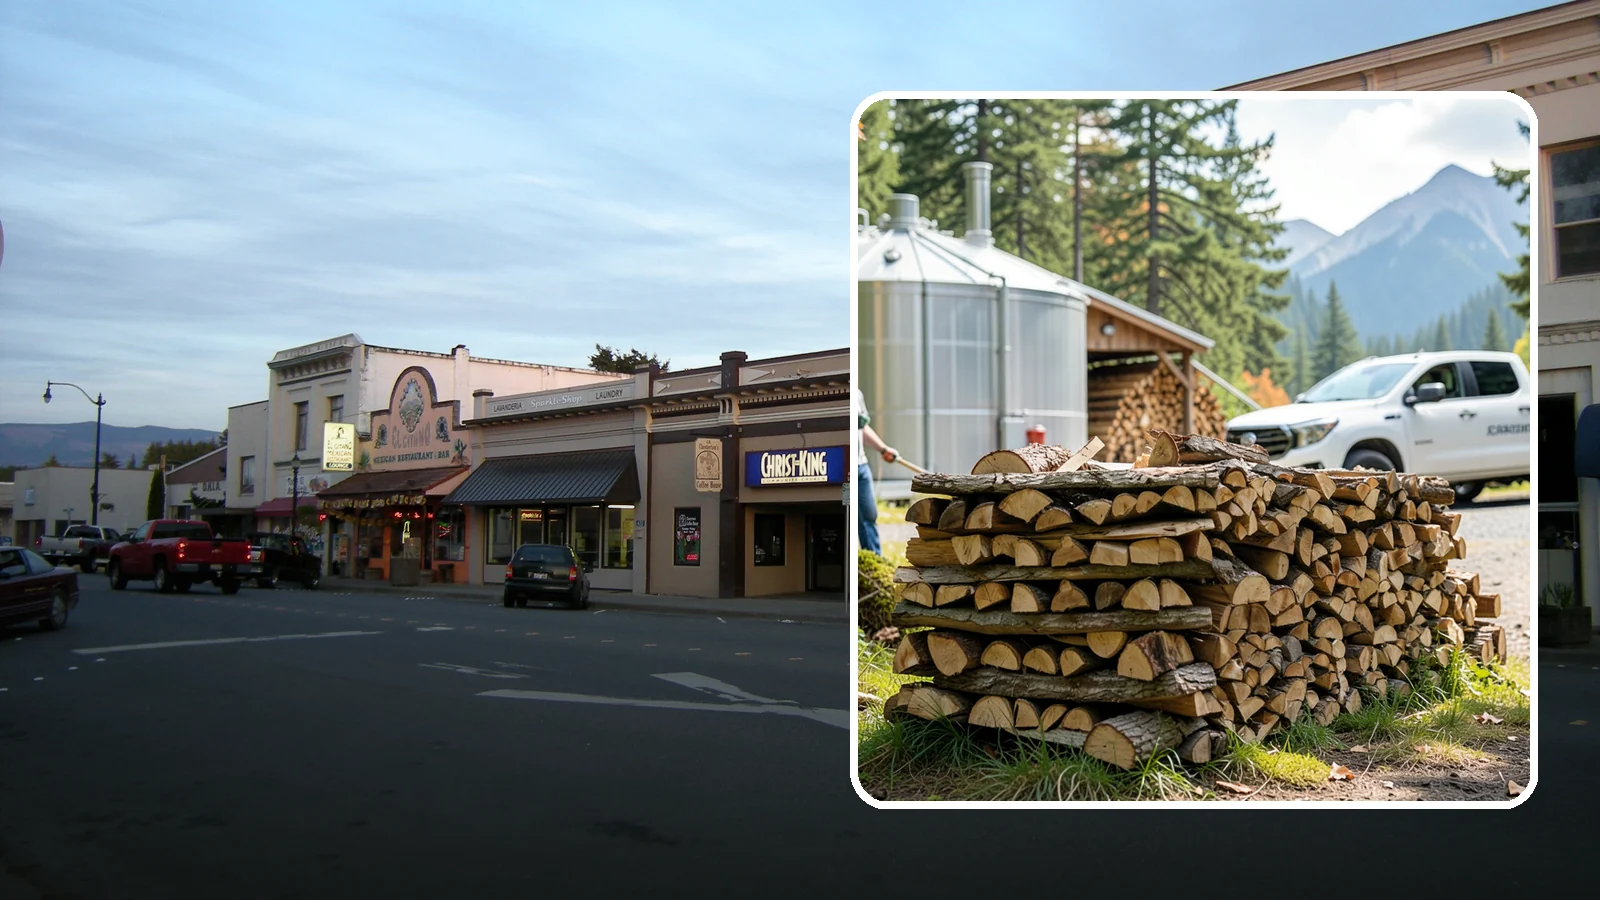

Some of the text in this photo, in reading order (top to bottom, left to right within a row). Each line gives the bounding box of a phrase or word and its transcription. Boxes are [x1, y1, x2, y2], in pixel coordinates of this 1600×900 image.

[595, 389, 623, 400] LAUNDRY
[493, 402, 522, 412] LAVANDERIA
[530, 394, 582, 409] Sparkle Shop
[374, 454, 396, 464] MEXICAN
[397, 451, 434, 462] RESTAURANT
[437, 449, 450, 459] BAR
[760, 450, 827, 478] CHRIST KING
[696, 480, 722, 489] Coffee House
